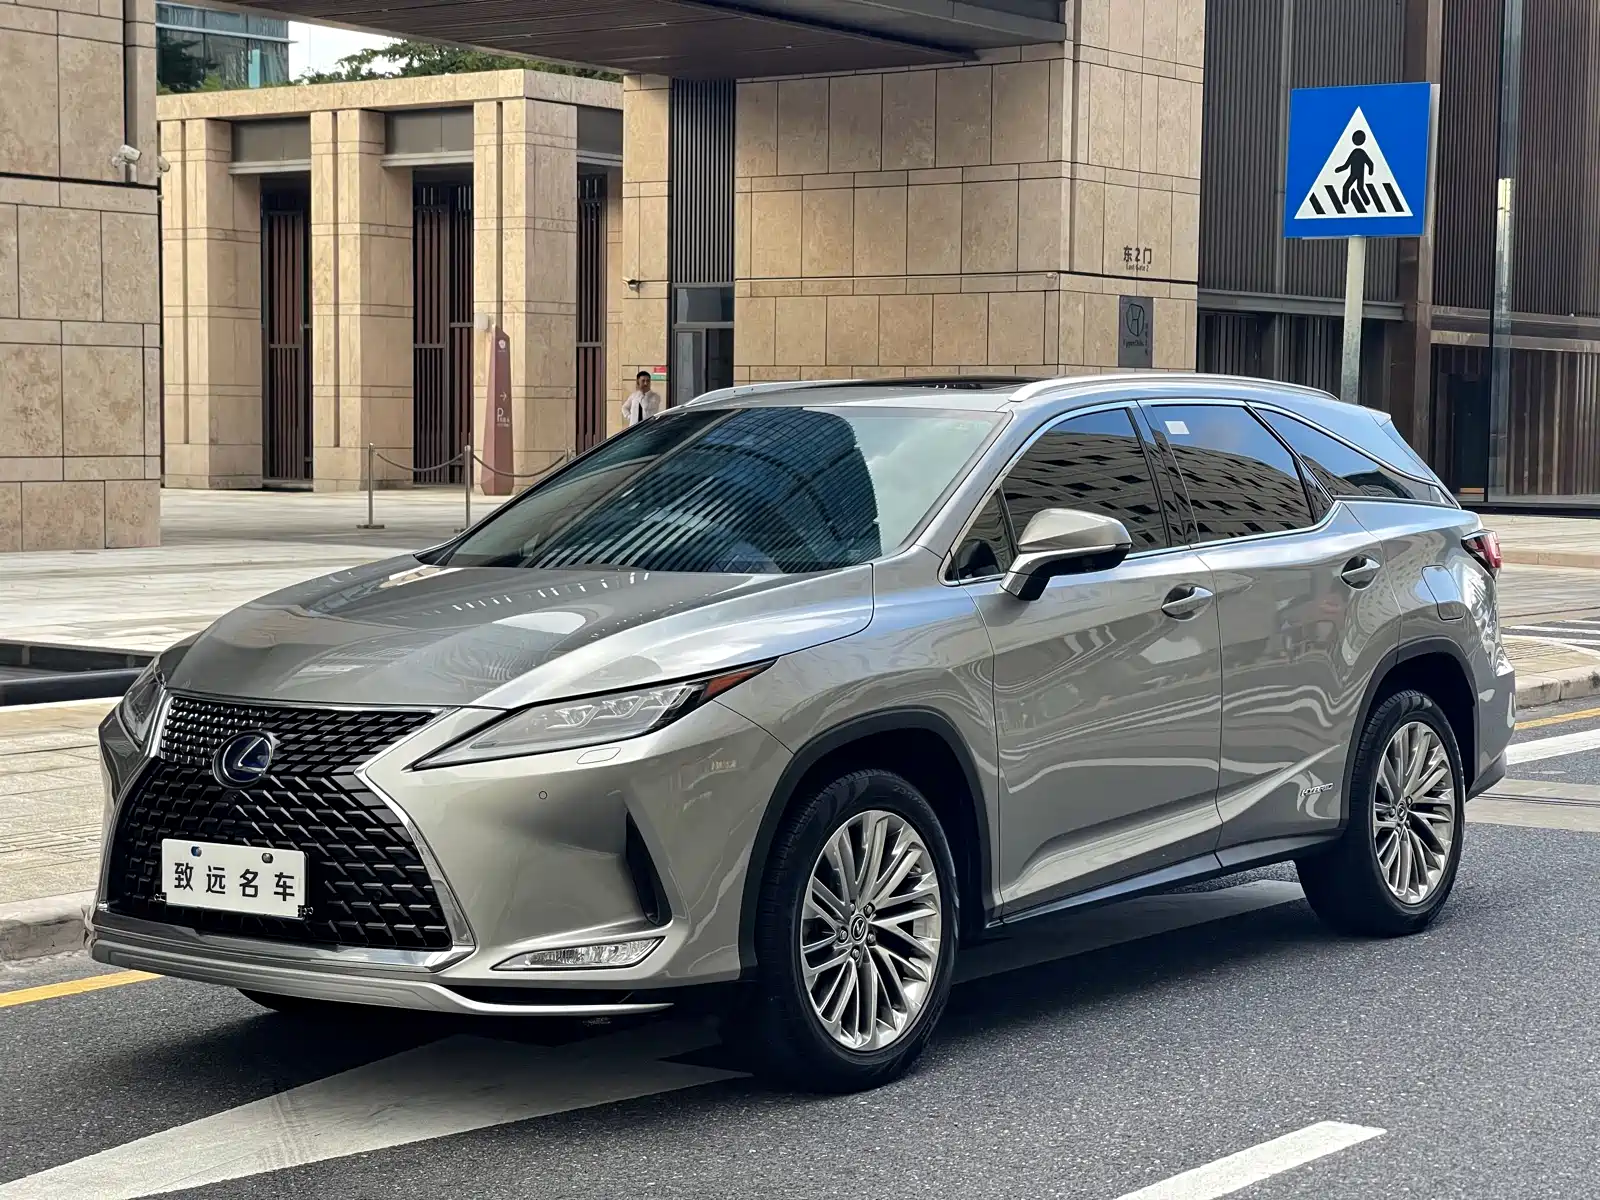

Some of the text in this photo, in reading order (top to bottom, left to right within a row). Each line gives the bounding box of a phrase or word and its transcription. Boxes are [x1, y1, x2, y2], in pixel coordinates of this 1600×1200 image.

[1123, 245, 1152, 264] 东2门
[174, 862, 295, 902] 致远名车
